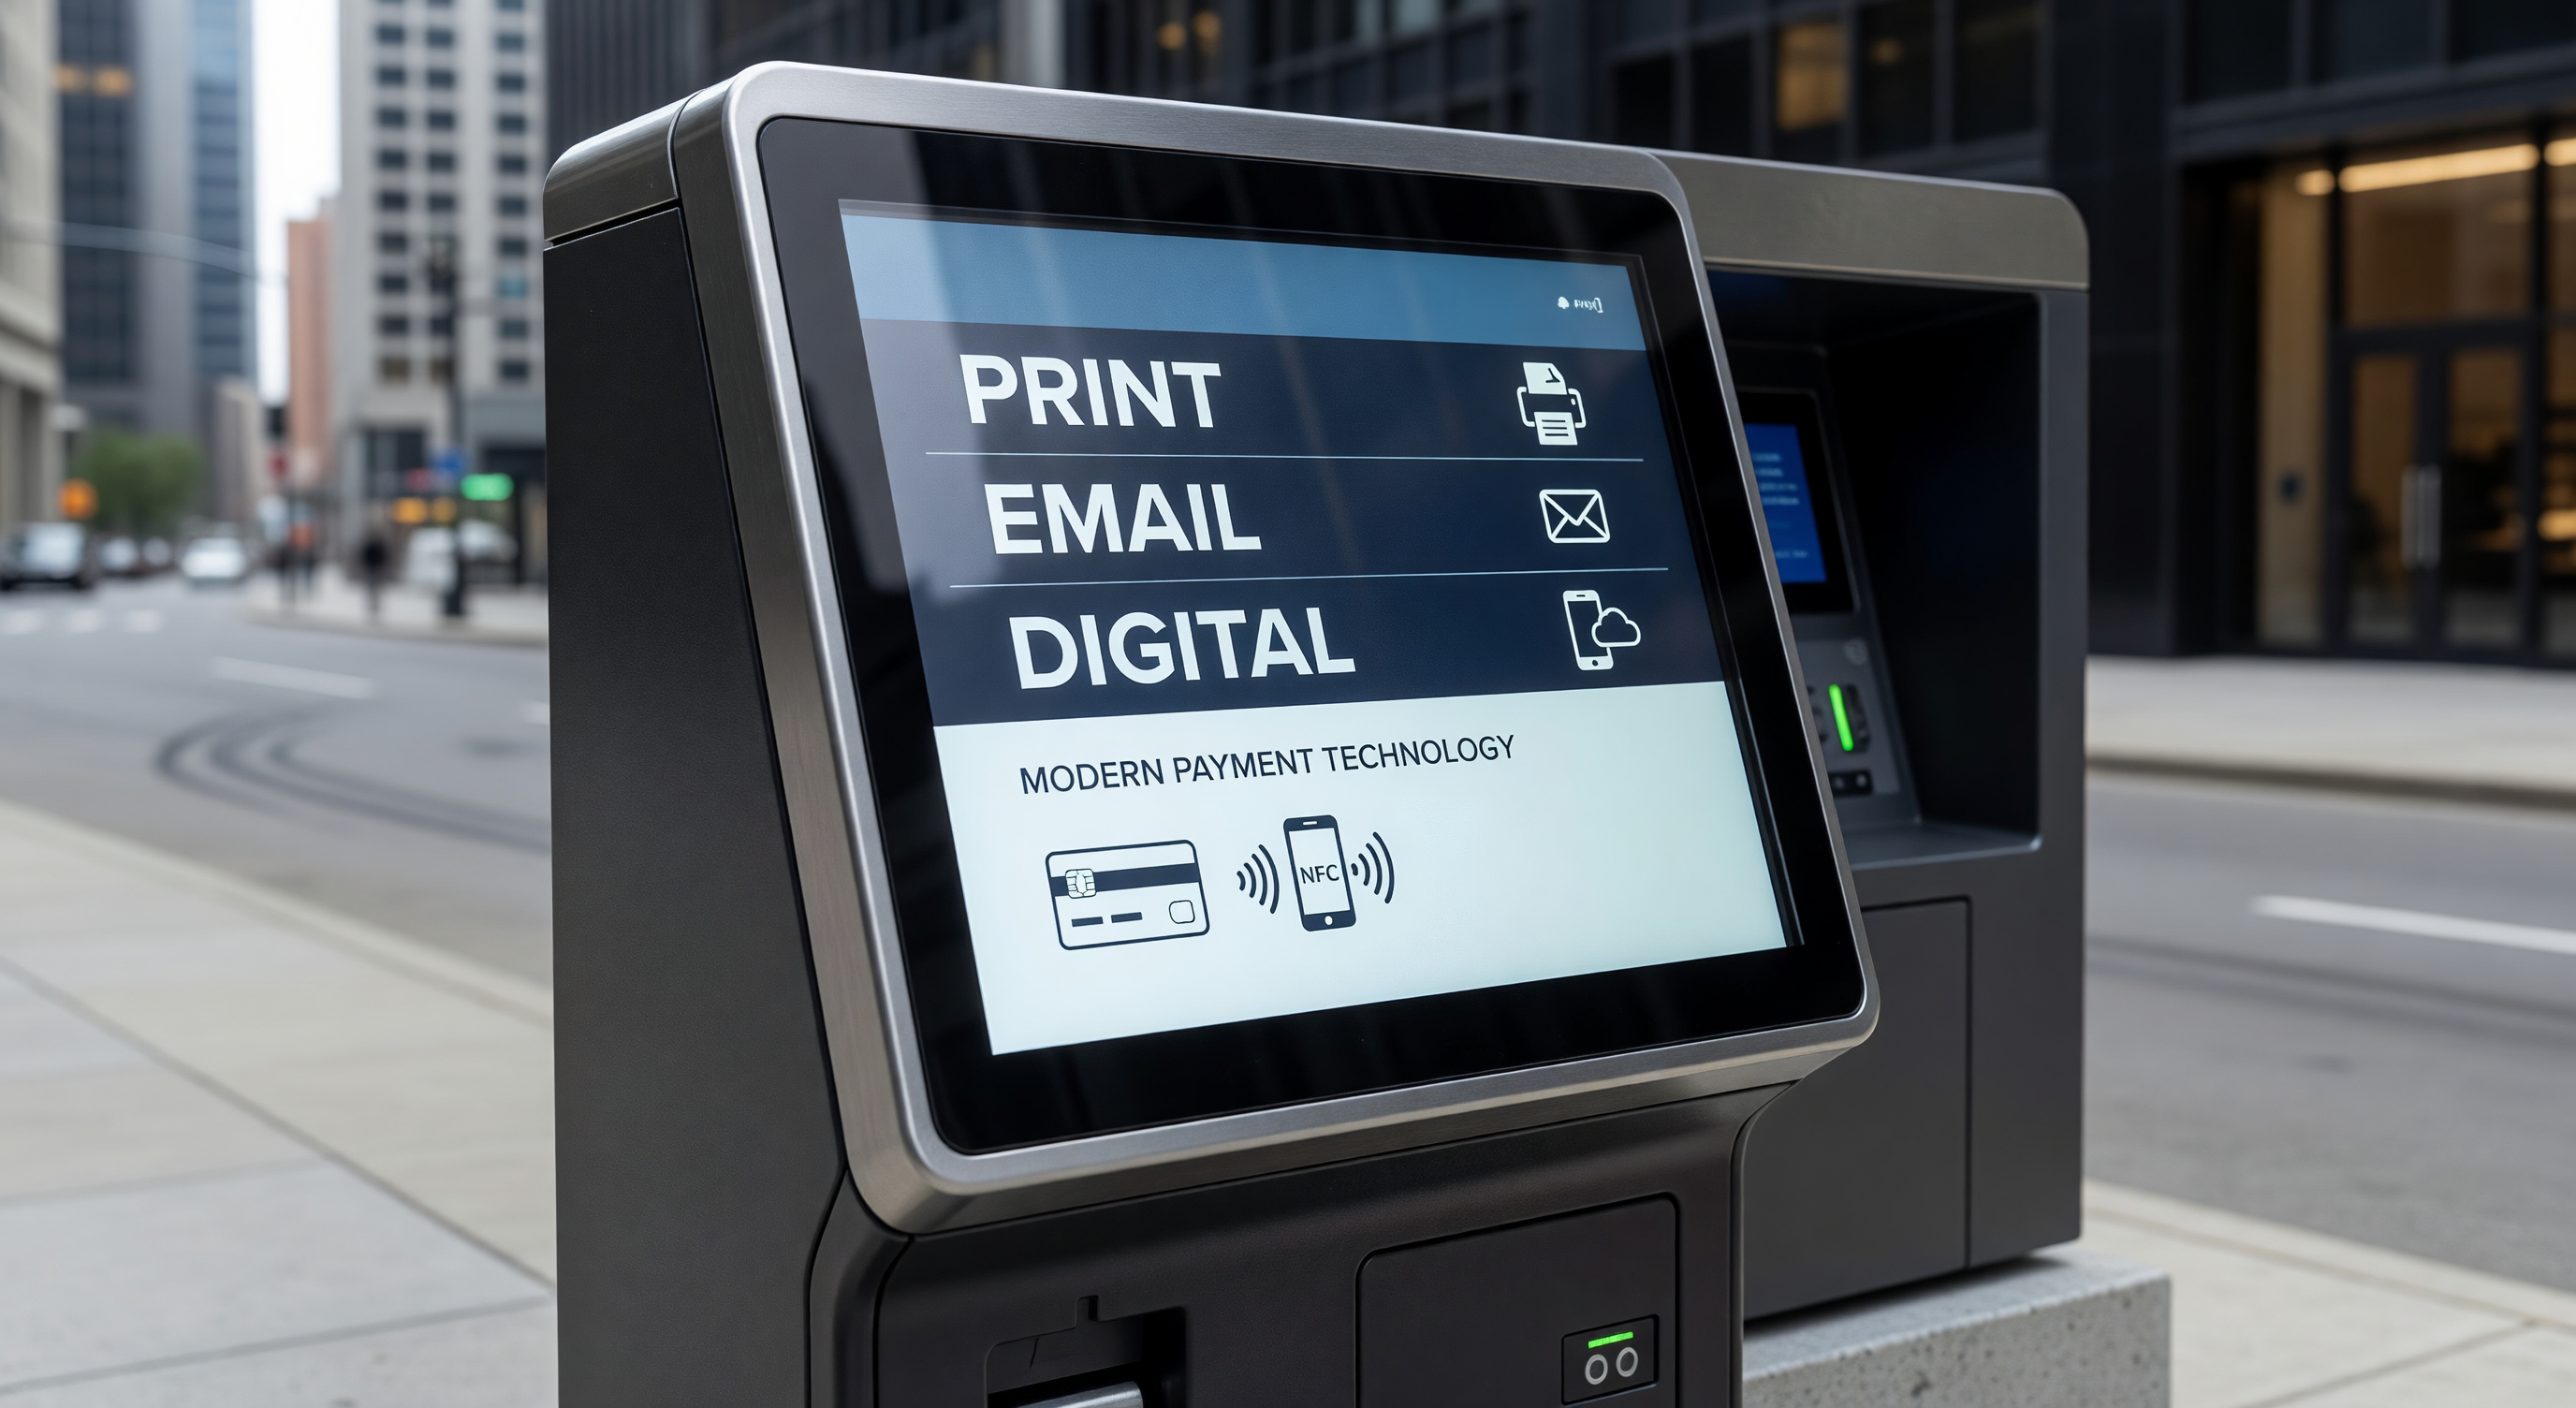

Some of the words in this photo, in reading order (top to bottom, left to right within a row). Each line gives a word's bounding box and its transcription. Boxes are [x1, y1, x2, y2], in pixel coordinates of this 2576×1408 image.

[959, 354, 1221, 429] PRINT
[985, 484, 1262, 554] EMAIL
[1009, 608, 1355, 689] DIGITAL
[1019, 758, 1164, 795] MODERN
[1173, 748, 1313, 784] PAYMENT
[1321, 734, 1515, 772] TECHNOLOGY
[1299, 864, 1339, 885] NFC
